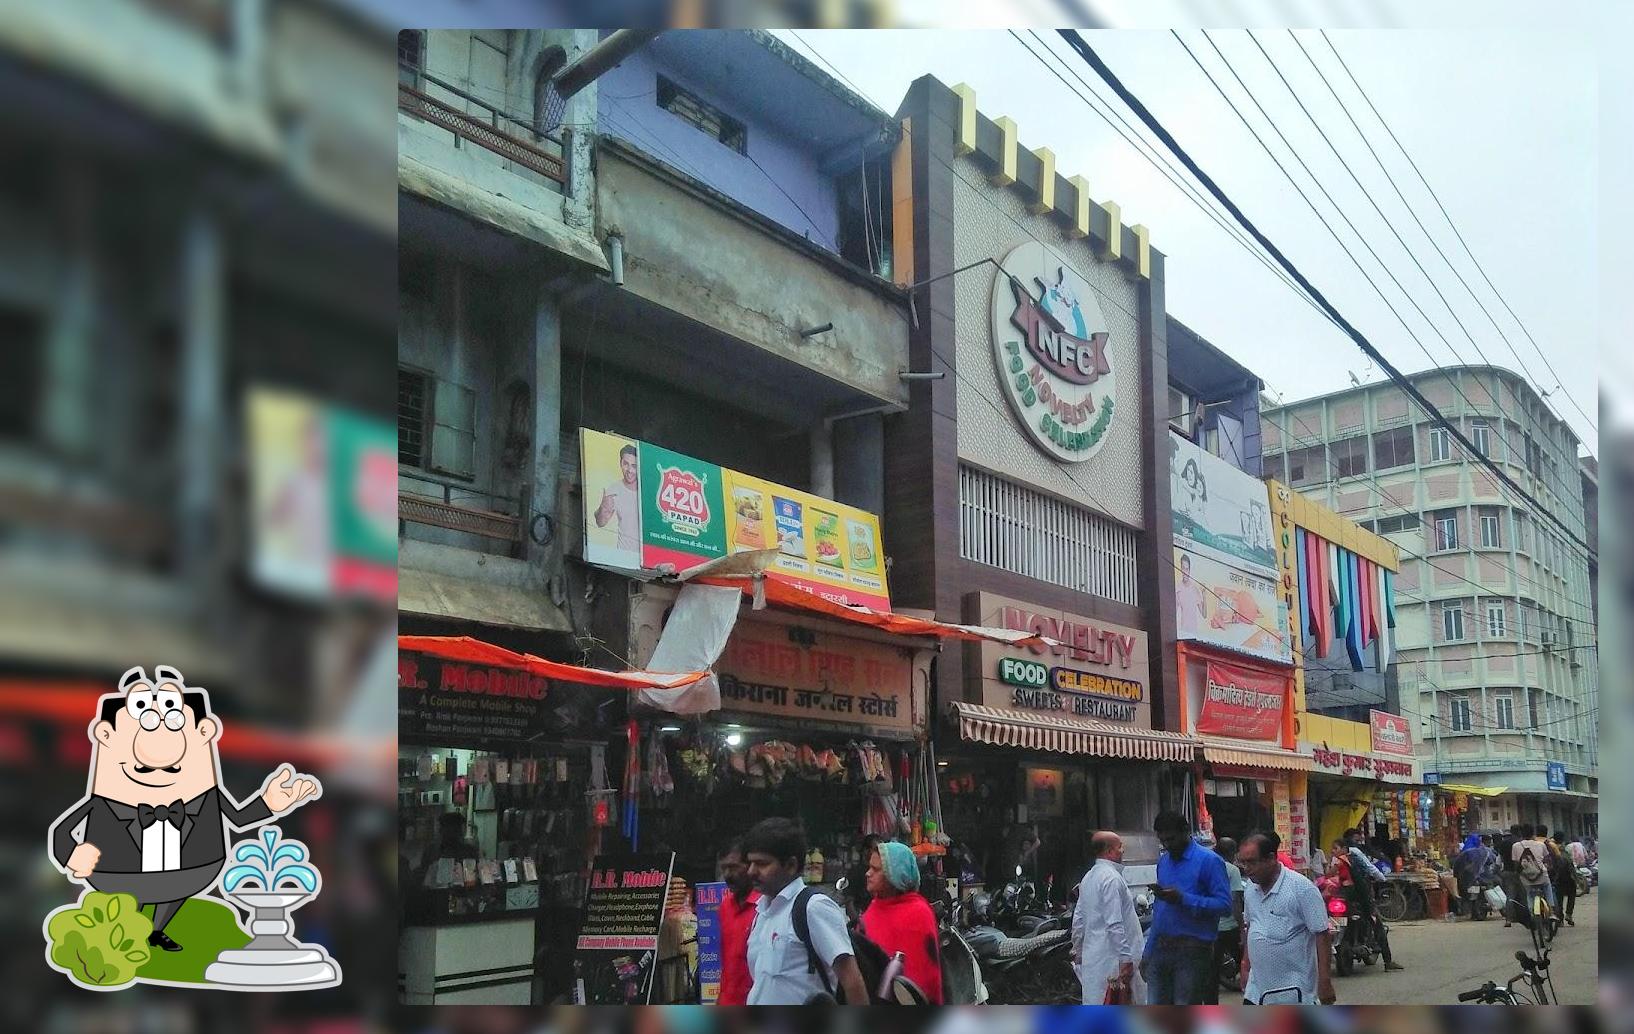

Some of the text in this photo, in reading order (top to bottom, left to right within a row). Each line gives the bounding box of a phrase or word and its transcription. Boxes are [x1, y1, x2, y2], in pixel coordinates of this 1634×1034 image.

[1037, 320, 1093, 375] NFC
[1005, 341, 1036, 407] FOOD
[1028, 364, 1095, 425] NOVELTY
[662, 484, 703, 514] 420
[671, 512, 700, 525] PAPAD
[1002, 607, 1136, 668] NOVELTY
[441, 663, 548, 700] Mobile
[1003, 660, 1141, 700] FOOD CELEBRATION
[419, 695, 427, 705] A
[430, 696, 476, 710] Complete
[515, 702, 537, 715] Shop
[1013, 688, 1062, 709] SWEETS
[1072, 697, 1137, 721] RESTAURANT
[1343, 754, 1372, 776] कुमार
[622, 869, 667, 888] Mobile
